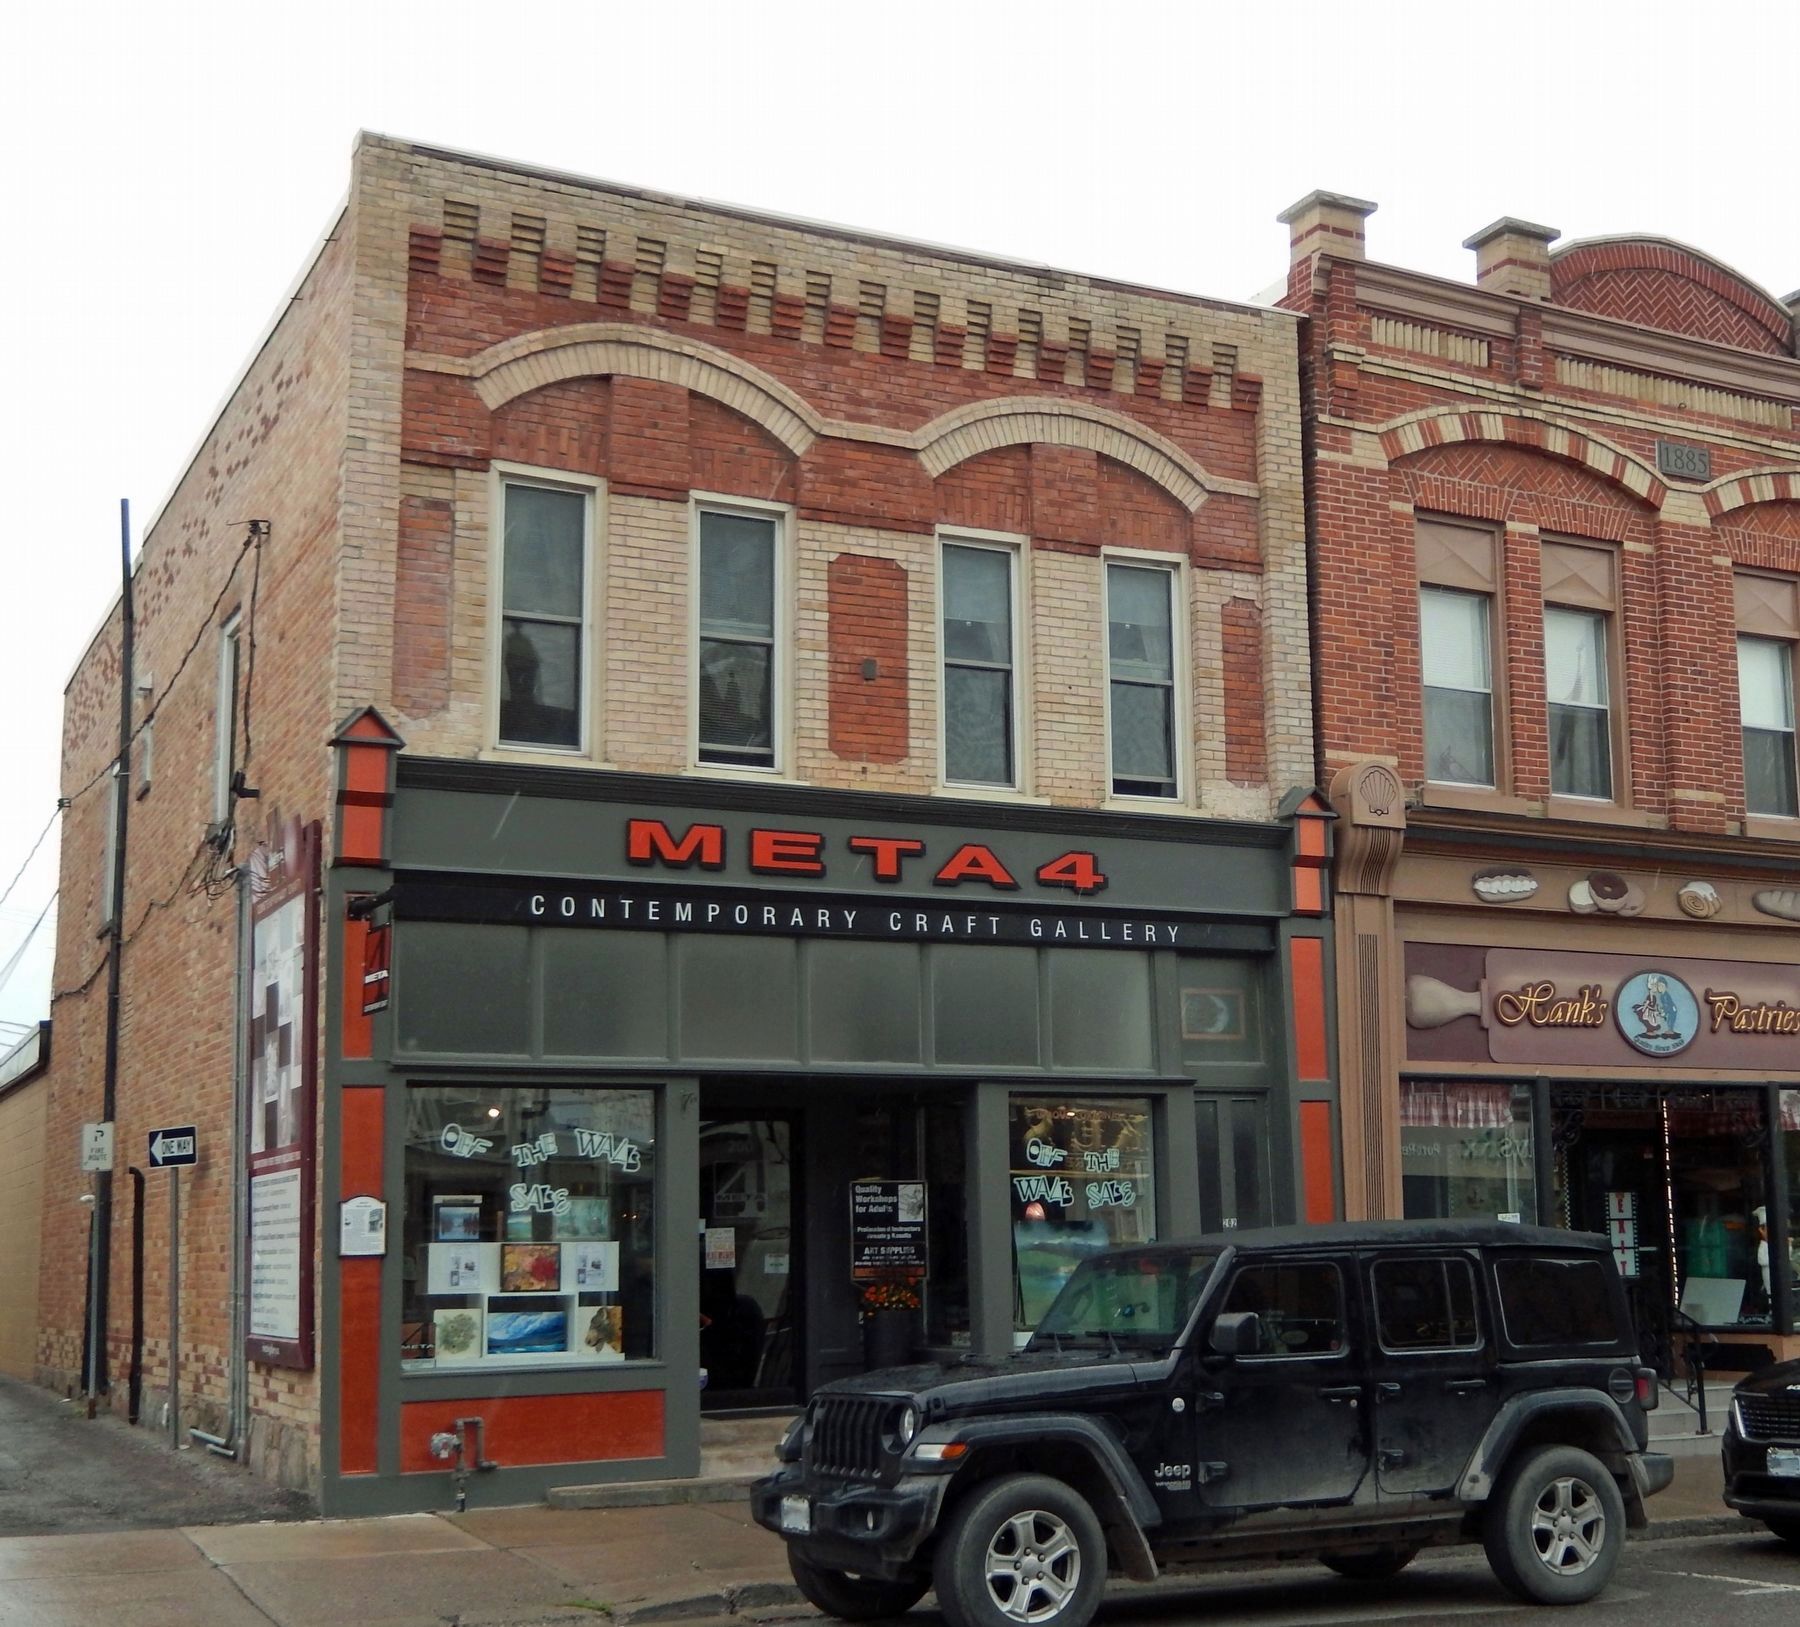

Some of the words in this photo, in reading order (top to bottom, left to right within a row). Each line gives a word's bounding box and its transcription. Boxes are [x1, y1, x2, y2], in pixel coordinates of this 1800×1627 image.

[1664, 446, 1707, 474] 1885
[530, 895, 857, 929] CONTEMPORARY
[889, 912, 1000, 935] CRAFT
[1030, 918, 1179, 943] GALLERY
[1498, 983, 1607, 1024] Hank's
[162, 1140, 175, 1155] ONE
[177, 1138, 191, 1153] WAY
[441, 1123, 493, 1158] OFF
[512, 1132, 558, 1167] THE
[574, 1128, 641, 1172] WALL
[1027, 1138, 1068, 1168] OFF
[1084, 1148, 1119, 1173] THE
[510, 1183, 571, 1216] SALE
[855, 1185, 882, 1195] Quality
[855, 1195, 897, 1204] Workshops
[1013, 1175, 1074, 1207] WALL
[1086, 1181, 1137, 1209] SALE
[855, 1205, 867, 1213] for
[1154, 1462, 1191, 1479] Jeep
